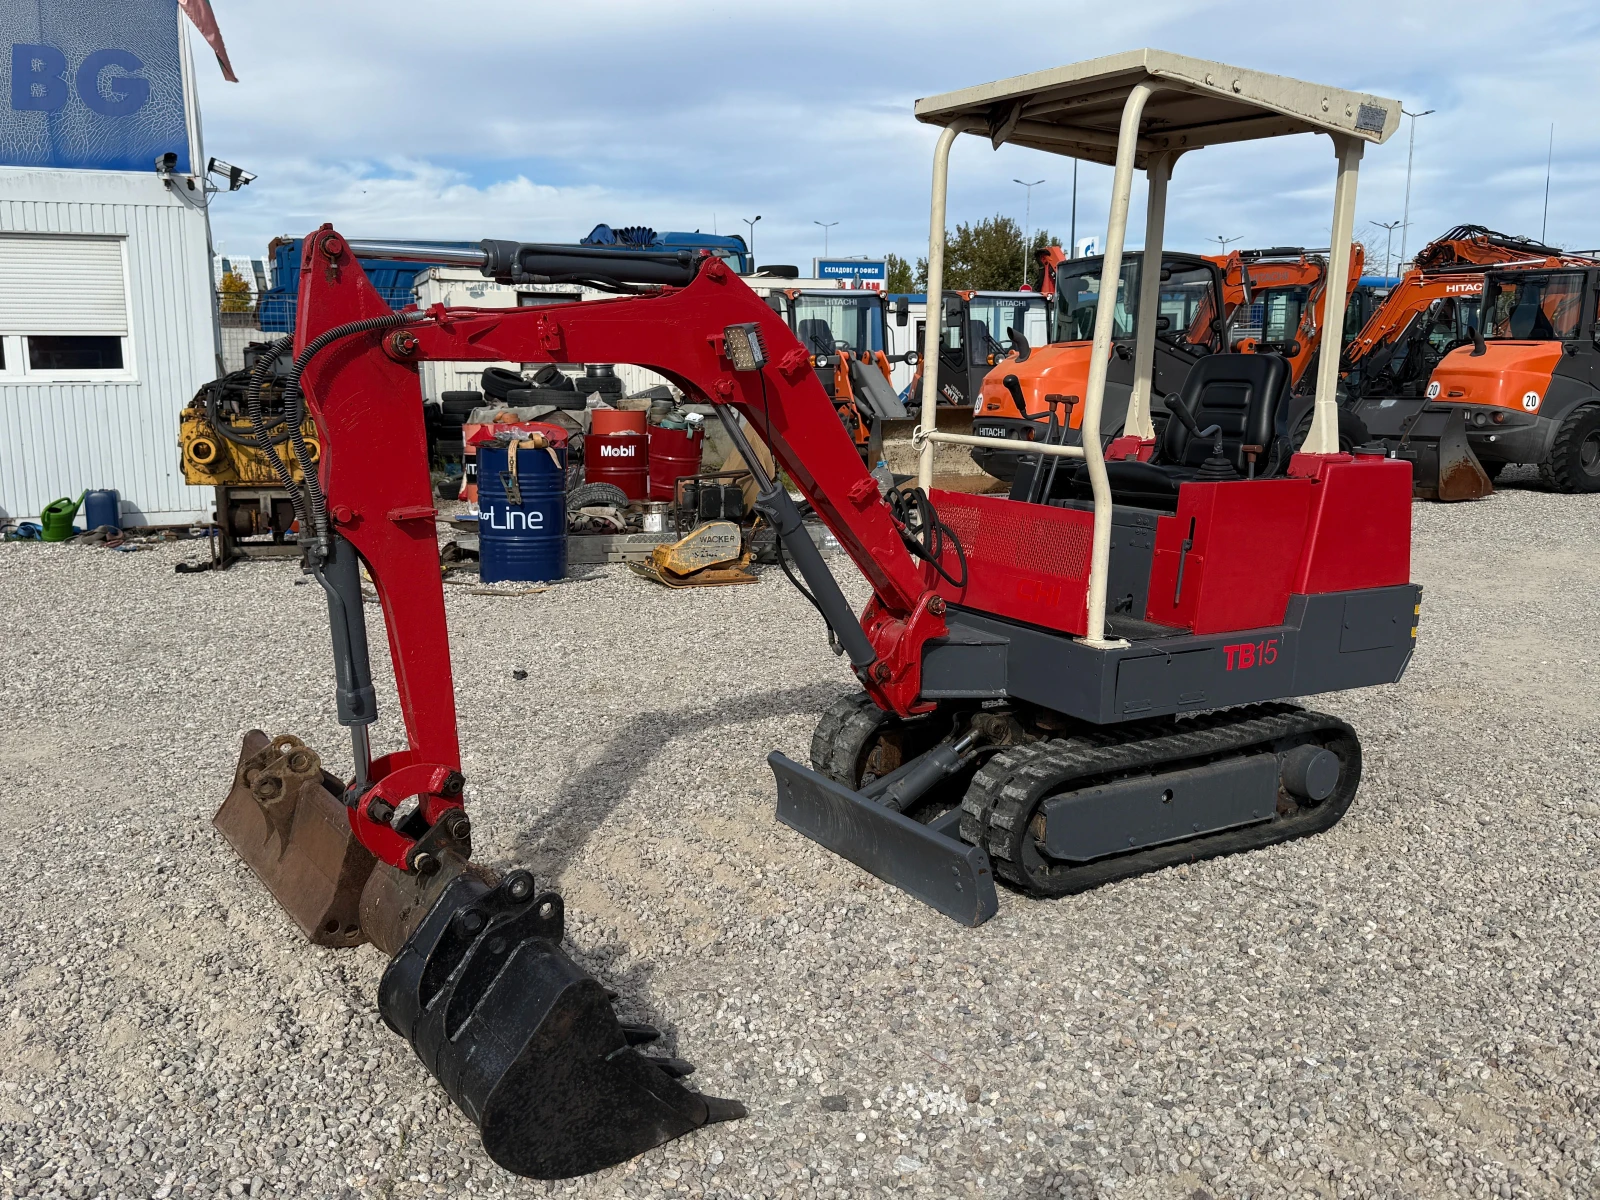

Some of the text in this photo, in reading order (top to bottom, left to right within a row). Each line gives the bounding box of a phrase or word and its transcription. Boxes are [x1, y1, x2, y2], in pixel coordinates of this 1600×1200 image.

[12, 43, 151, 117] BG
[824, 266, 853, 274] СКЛАДОВЕ
[824, 298, 858, 306] HITACHI
[1428, 385, 1439, 396] 20
[1525, 395, 1537, 407] 20
[979, 427, 1006, 437] HITACHI
[600, 444, 635, 457] Mobil
[699, 535, 736, 544] WACKER
[1223, 639, 1279, 672] TB15
